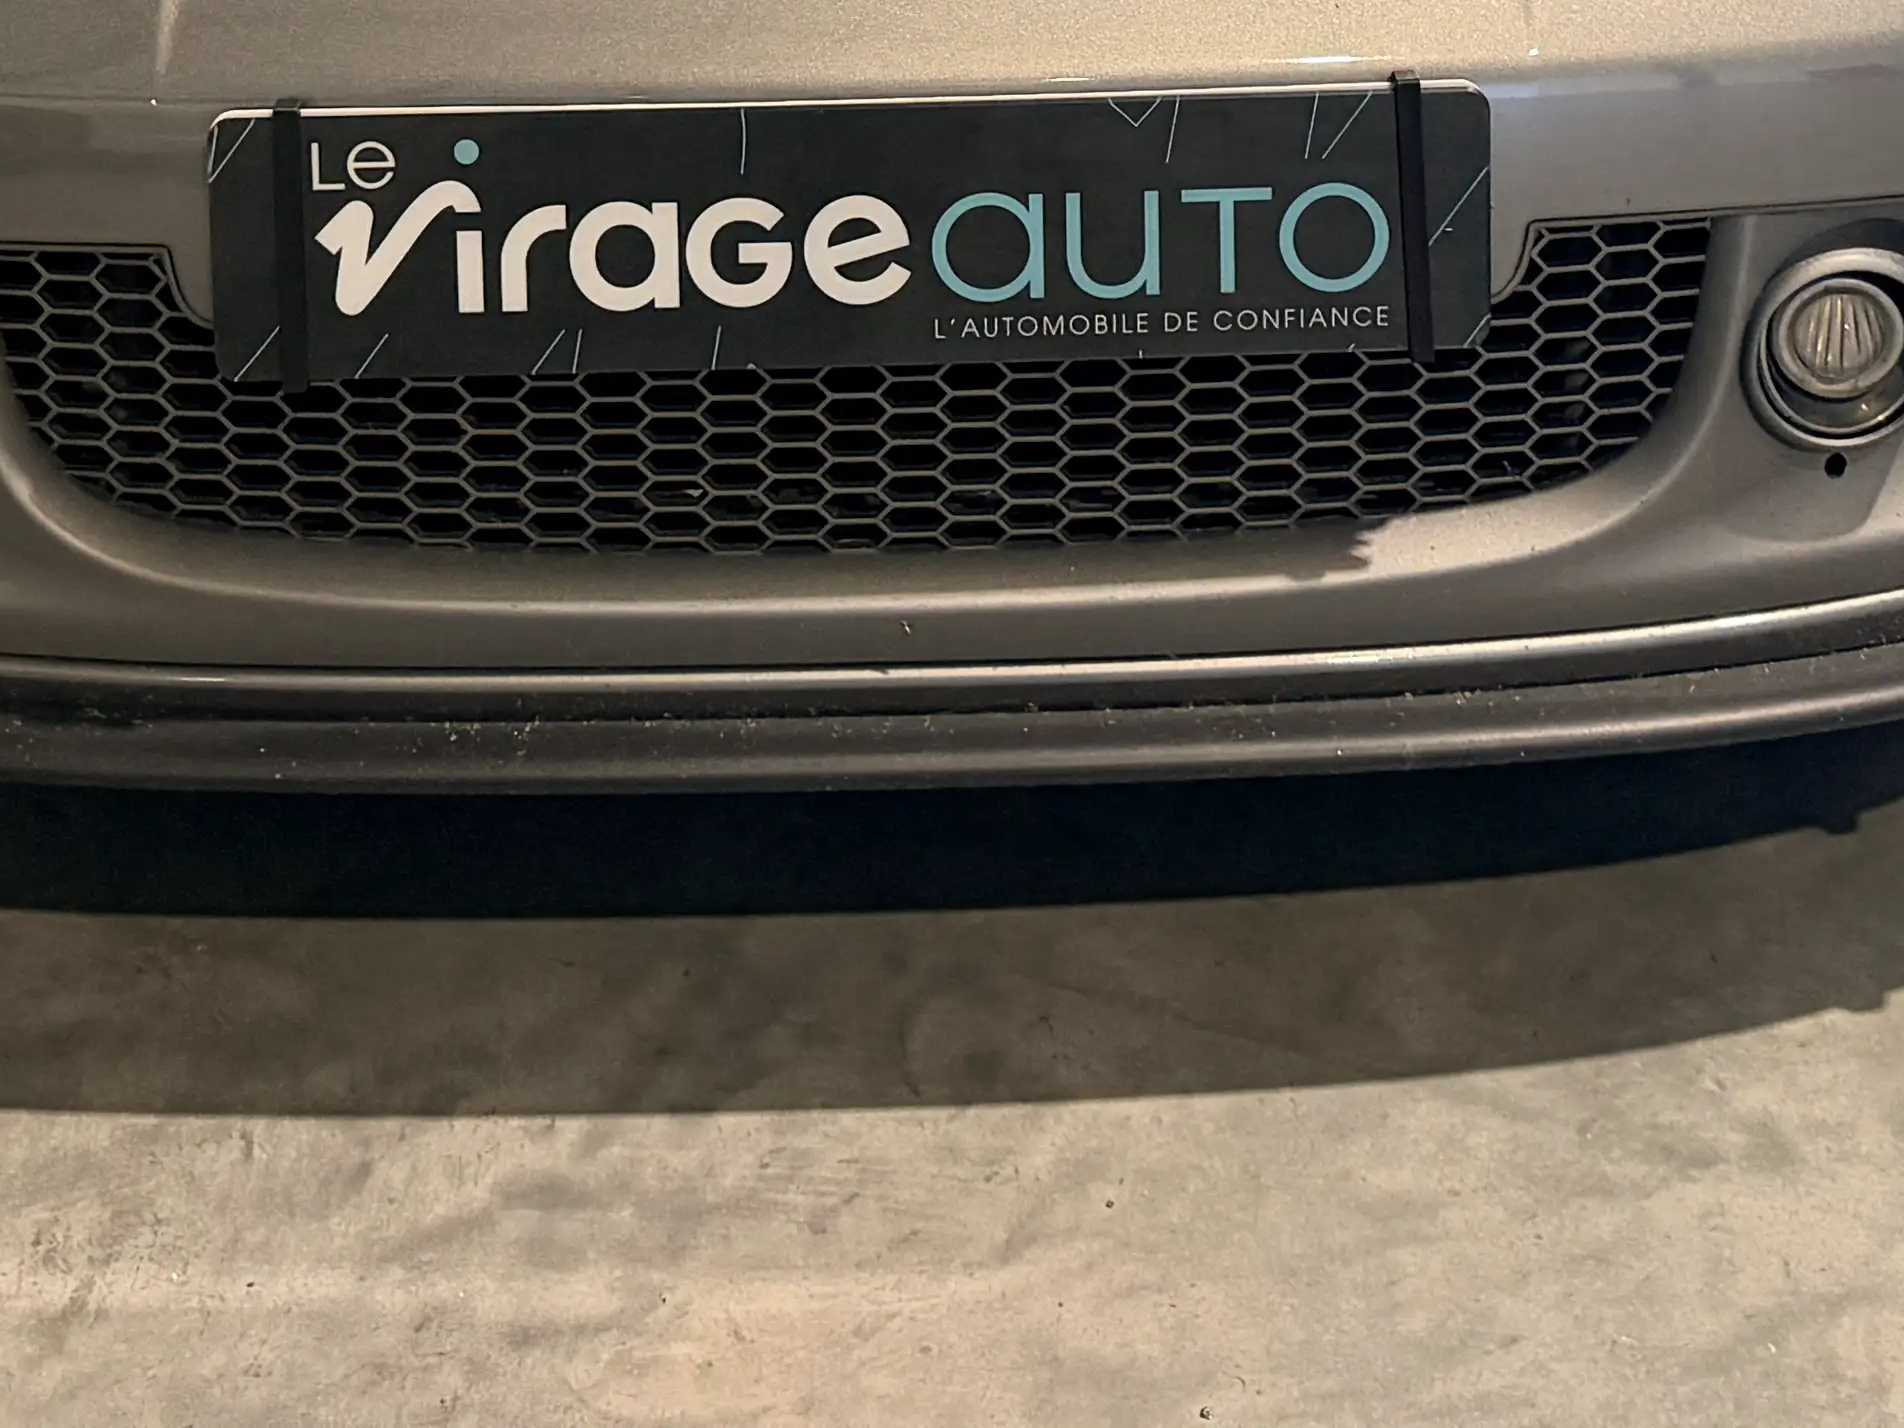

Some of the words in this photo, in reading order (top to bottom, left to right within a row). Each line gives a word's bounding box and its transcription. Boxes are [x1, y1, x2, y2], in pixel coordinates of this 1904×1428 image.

[310, 140, 397, 192] Le
[934, 312, 1150, 340] L'AUTOMOBILE
[1164, 311, 1199, 333] DE
[1213, 305, 1391, 332] CONFIANCE
